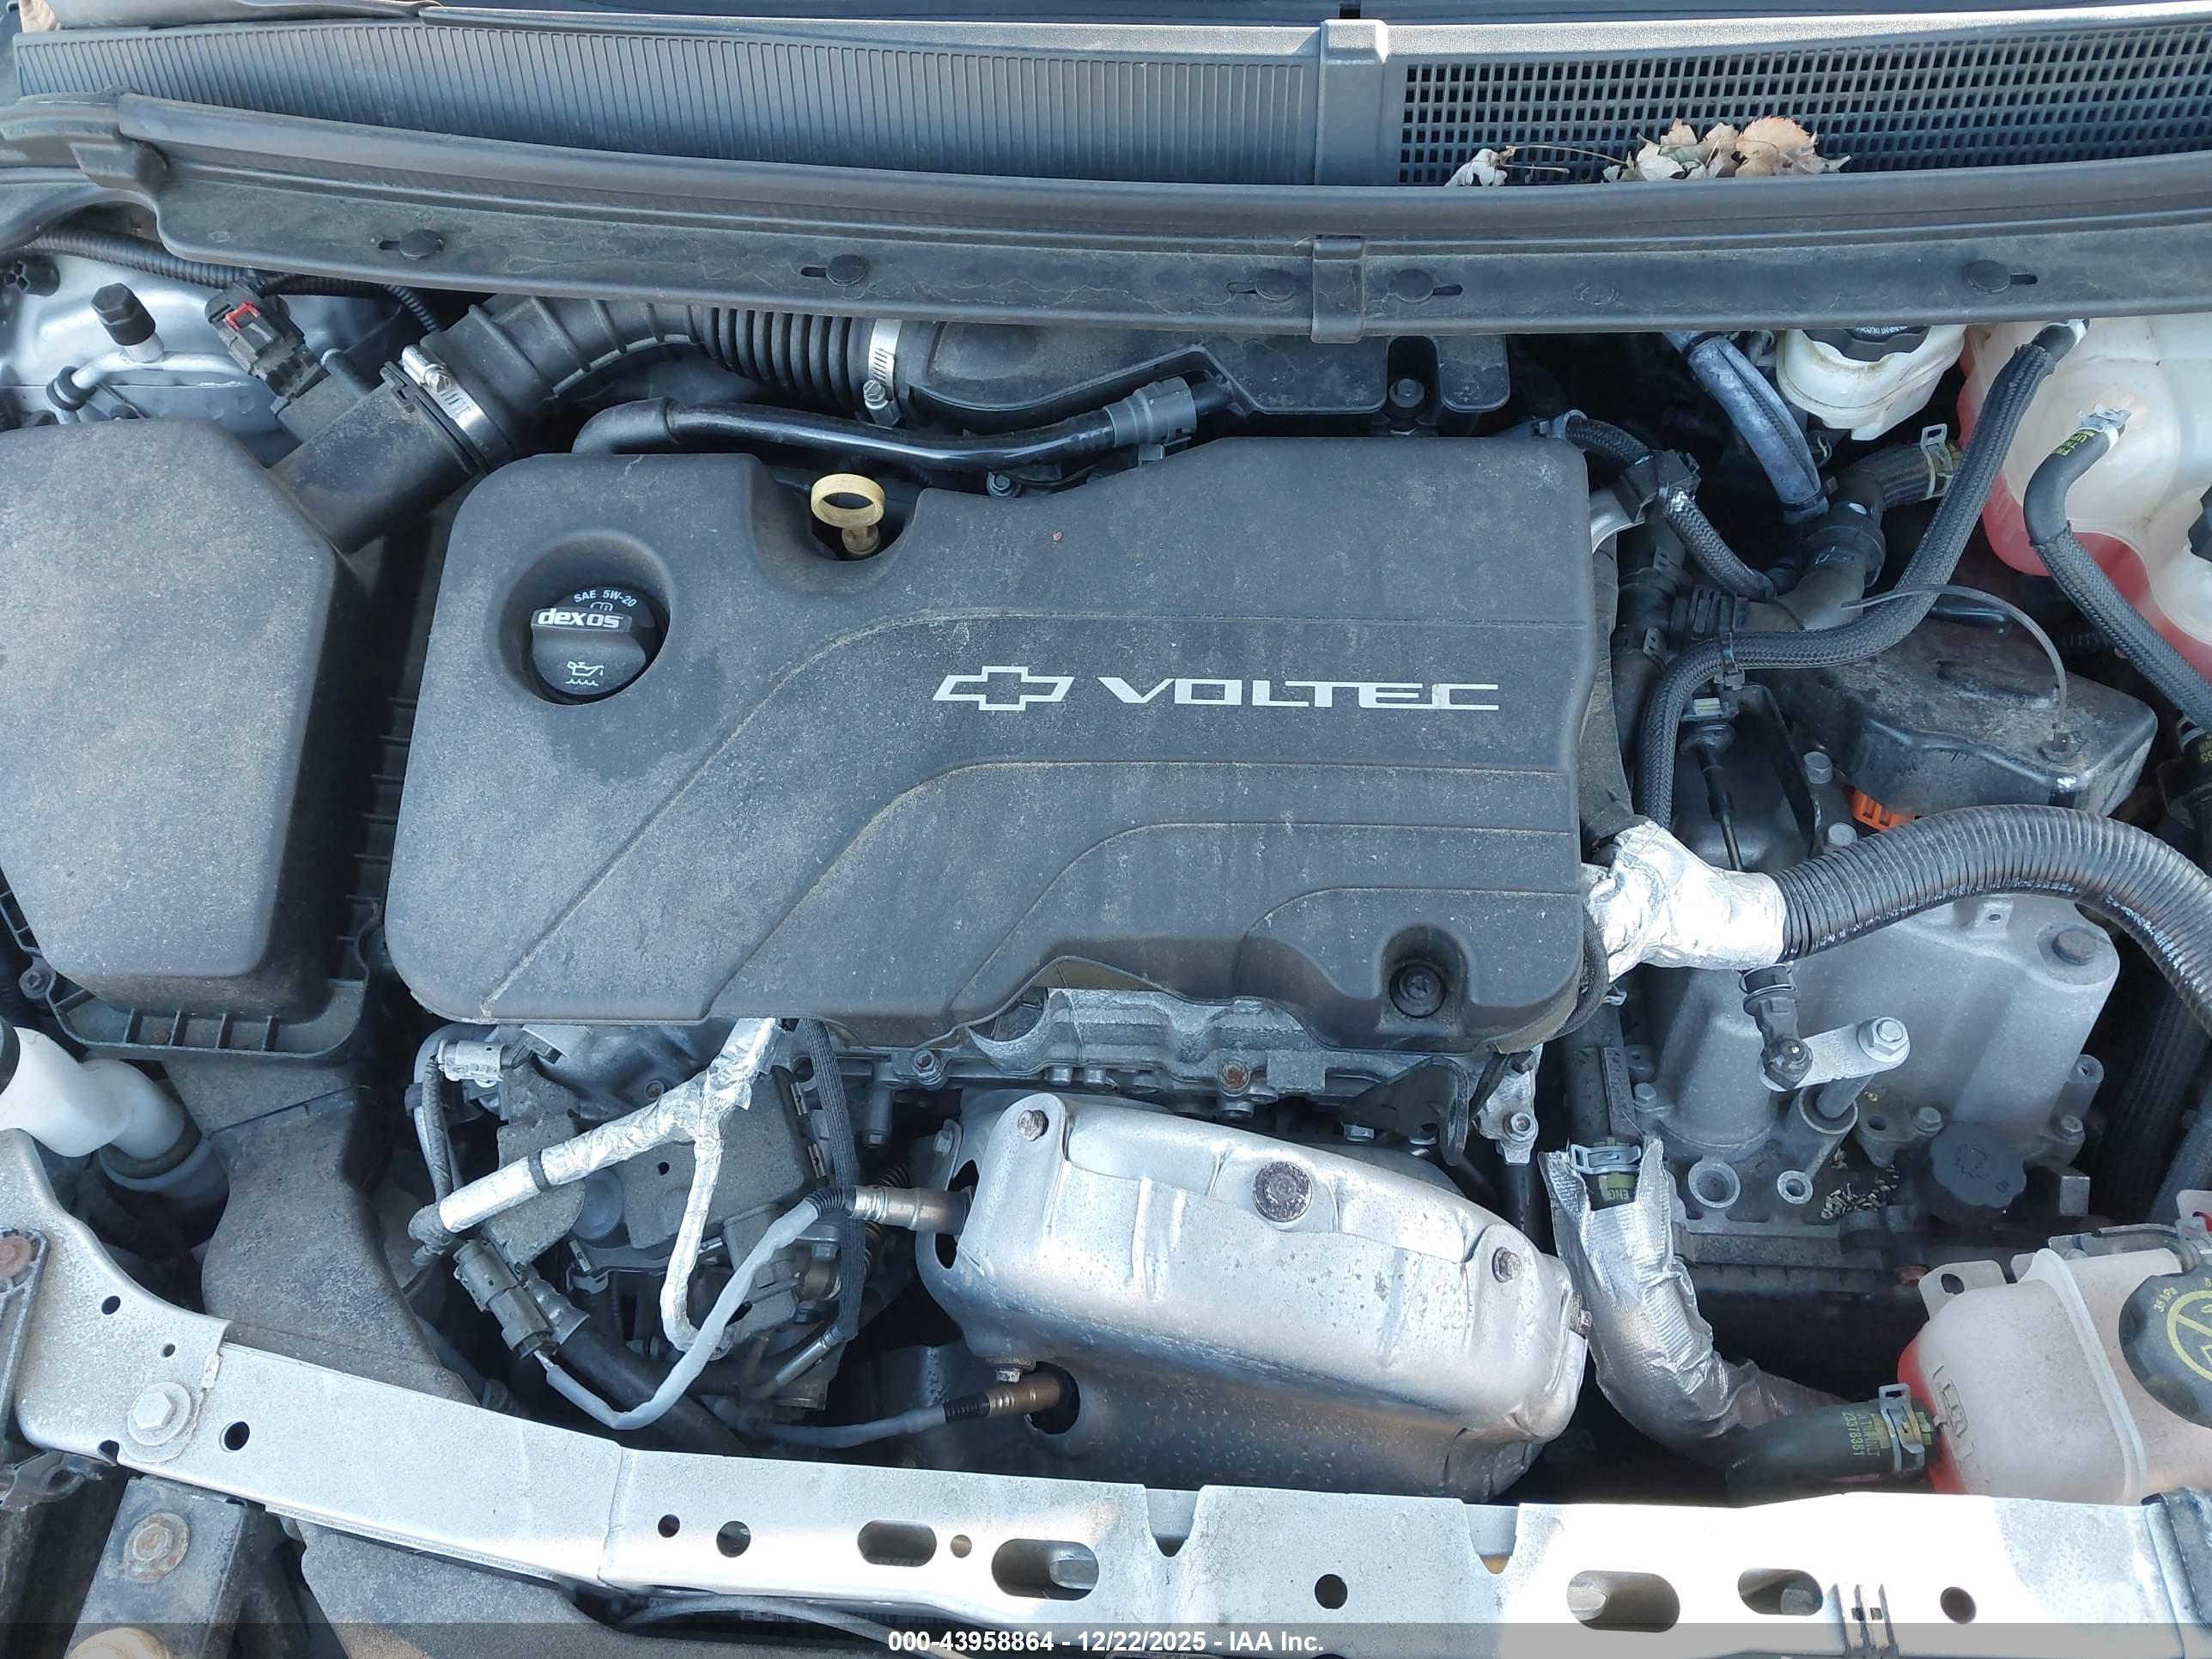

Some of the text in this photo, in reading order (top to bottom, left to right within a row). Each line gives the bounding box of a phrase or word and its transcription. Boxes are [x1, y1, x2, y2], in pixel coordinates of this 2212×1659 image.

[574, 588, 637, 607] SAE 5W-20
[538, 608, 621, 629] dexos
[1097, 677, 1500, 711] VOLTEC
